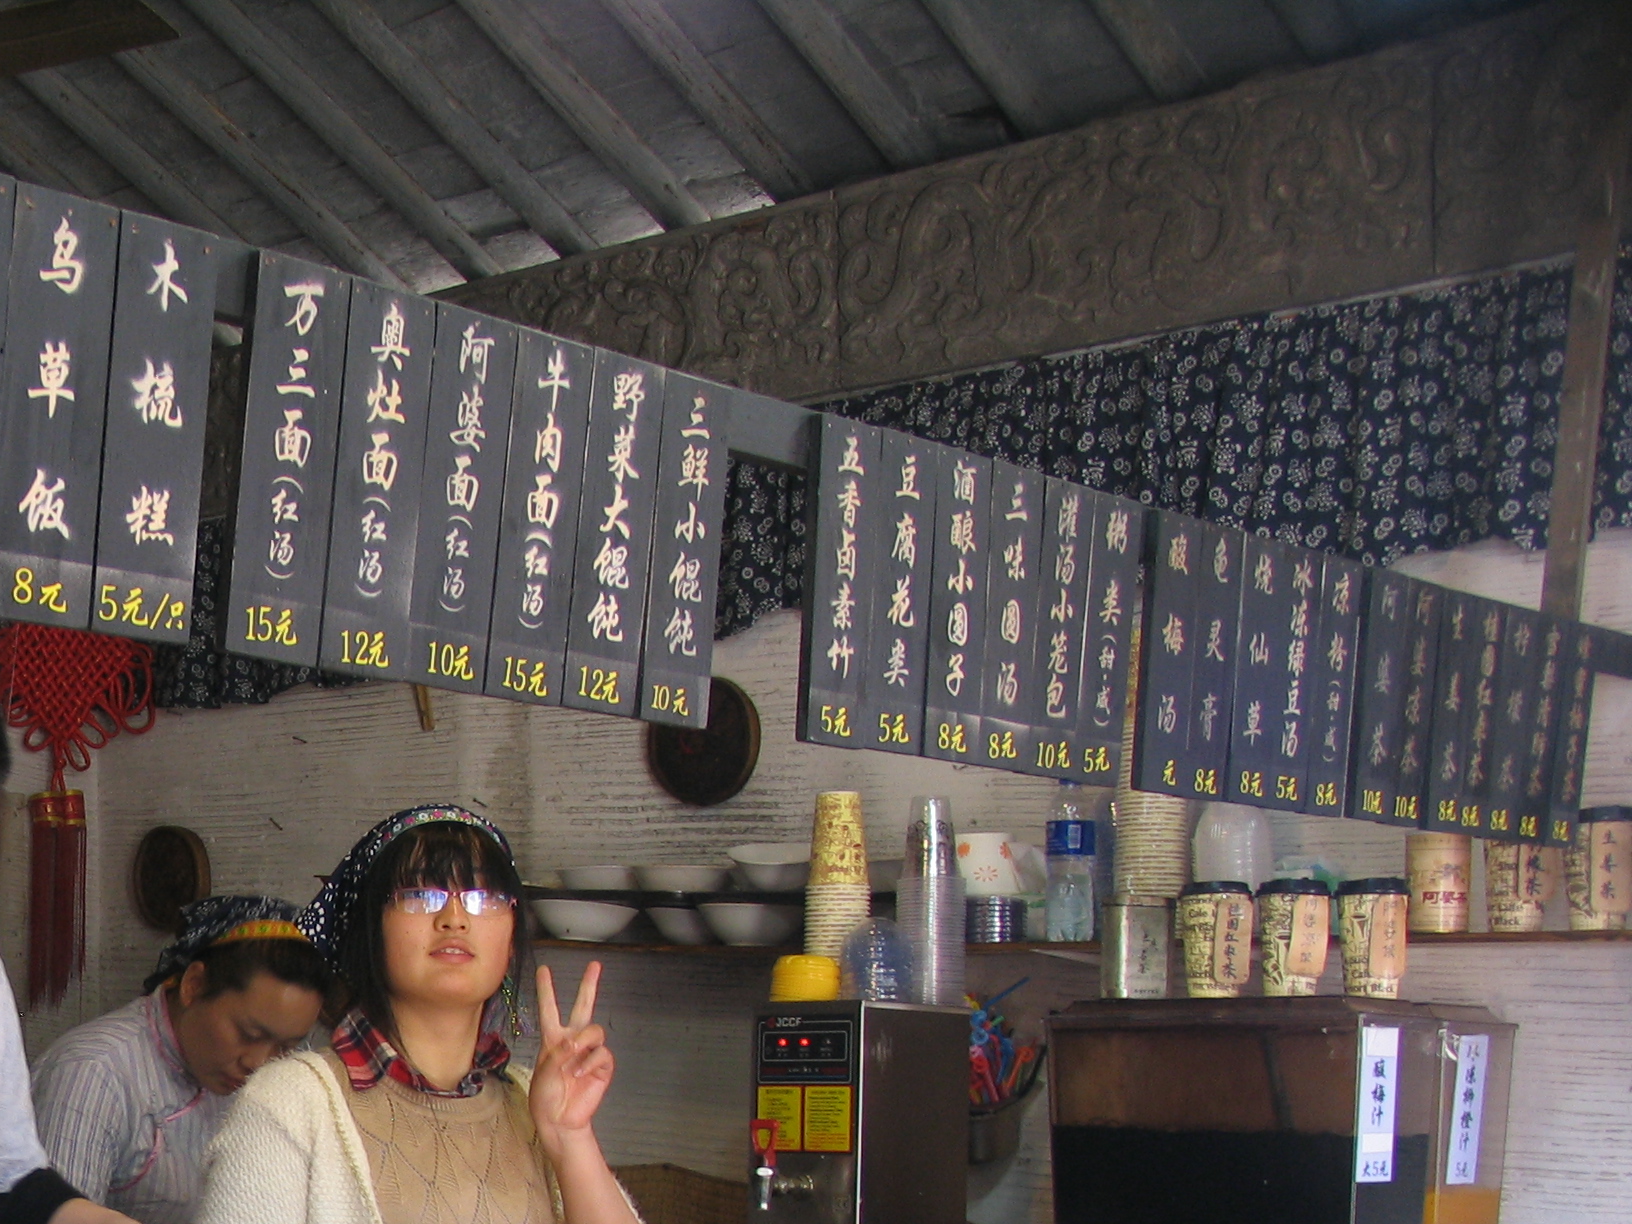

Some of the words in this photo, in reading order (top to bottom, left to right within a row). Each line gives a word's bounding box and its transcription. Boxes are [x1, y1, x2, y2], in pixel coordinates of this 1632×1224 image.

[18, 216, 86, 539] 乌草饭
[126, 239, 188, 546] 木梳糕
[587, 372, 646, 643] 野菜大馄饨
[663, 396, 710, 658] 三鲜小馄饨
[12, 567, 67, 613] 8元
[883, 455, 921, 688] 豆腐花类
[945, 456, 977, 697] 酒酿小圆子
[99, 586, 185, 630] 5元/只
[1045, 494, 1079, 719] 灌汤小笼包
[245, 606, 298, 647] 15元
[1158, 533, 1188, 734] 酸梅汤
[1199, 537, 1228, 742] 龟灵膏
[340, 631, 389, 669] 12元
[427, 643, 474, 682] 10元
[1243, 554, 1273, 746] 烧仙草
[503, 657, 548, 698] 15元
[578, 666, 620, 704] 12元
[1370, 584, 1399, 766] 阿婆茶
[651, 684, 689, 716] 10元
[820, 705, 851, 737] 5元
[878, 713, 910, 744] 5元
[938, 723, 968, 753] 8元
[988, 732, 1017, 760] 8元
[1037, 742, 1070, 769] 10元
[1083, 747, 1110, 773] 5元
[1194, 768, 1217, 794] 8元
[1240, 771, 1263, 797] 8元
[1276, 775, 1298, 801] 5元
[1315, 782, 1337, 806] 8元
[1362, 789, 1383, 815] 10元
[1394, 795, 1417, 819] 10元
[1438, 799, 1457, 821] 8元
[1461, 805, 1480, 827] 8元
[1490, 809, 1508, 831] 8元
[1520, 816, 1537, 837] 8元
[1553, 820, 1569, 842] 8元
[1371, 1058, 1386, 1127] 酸梅汁
